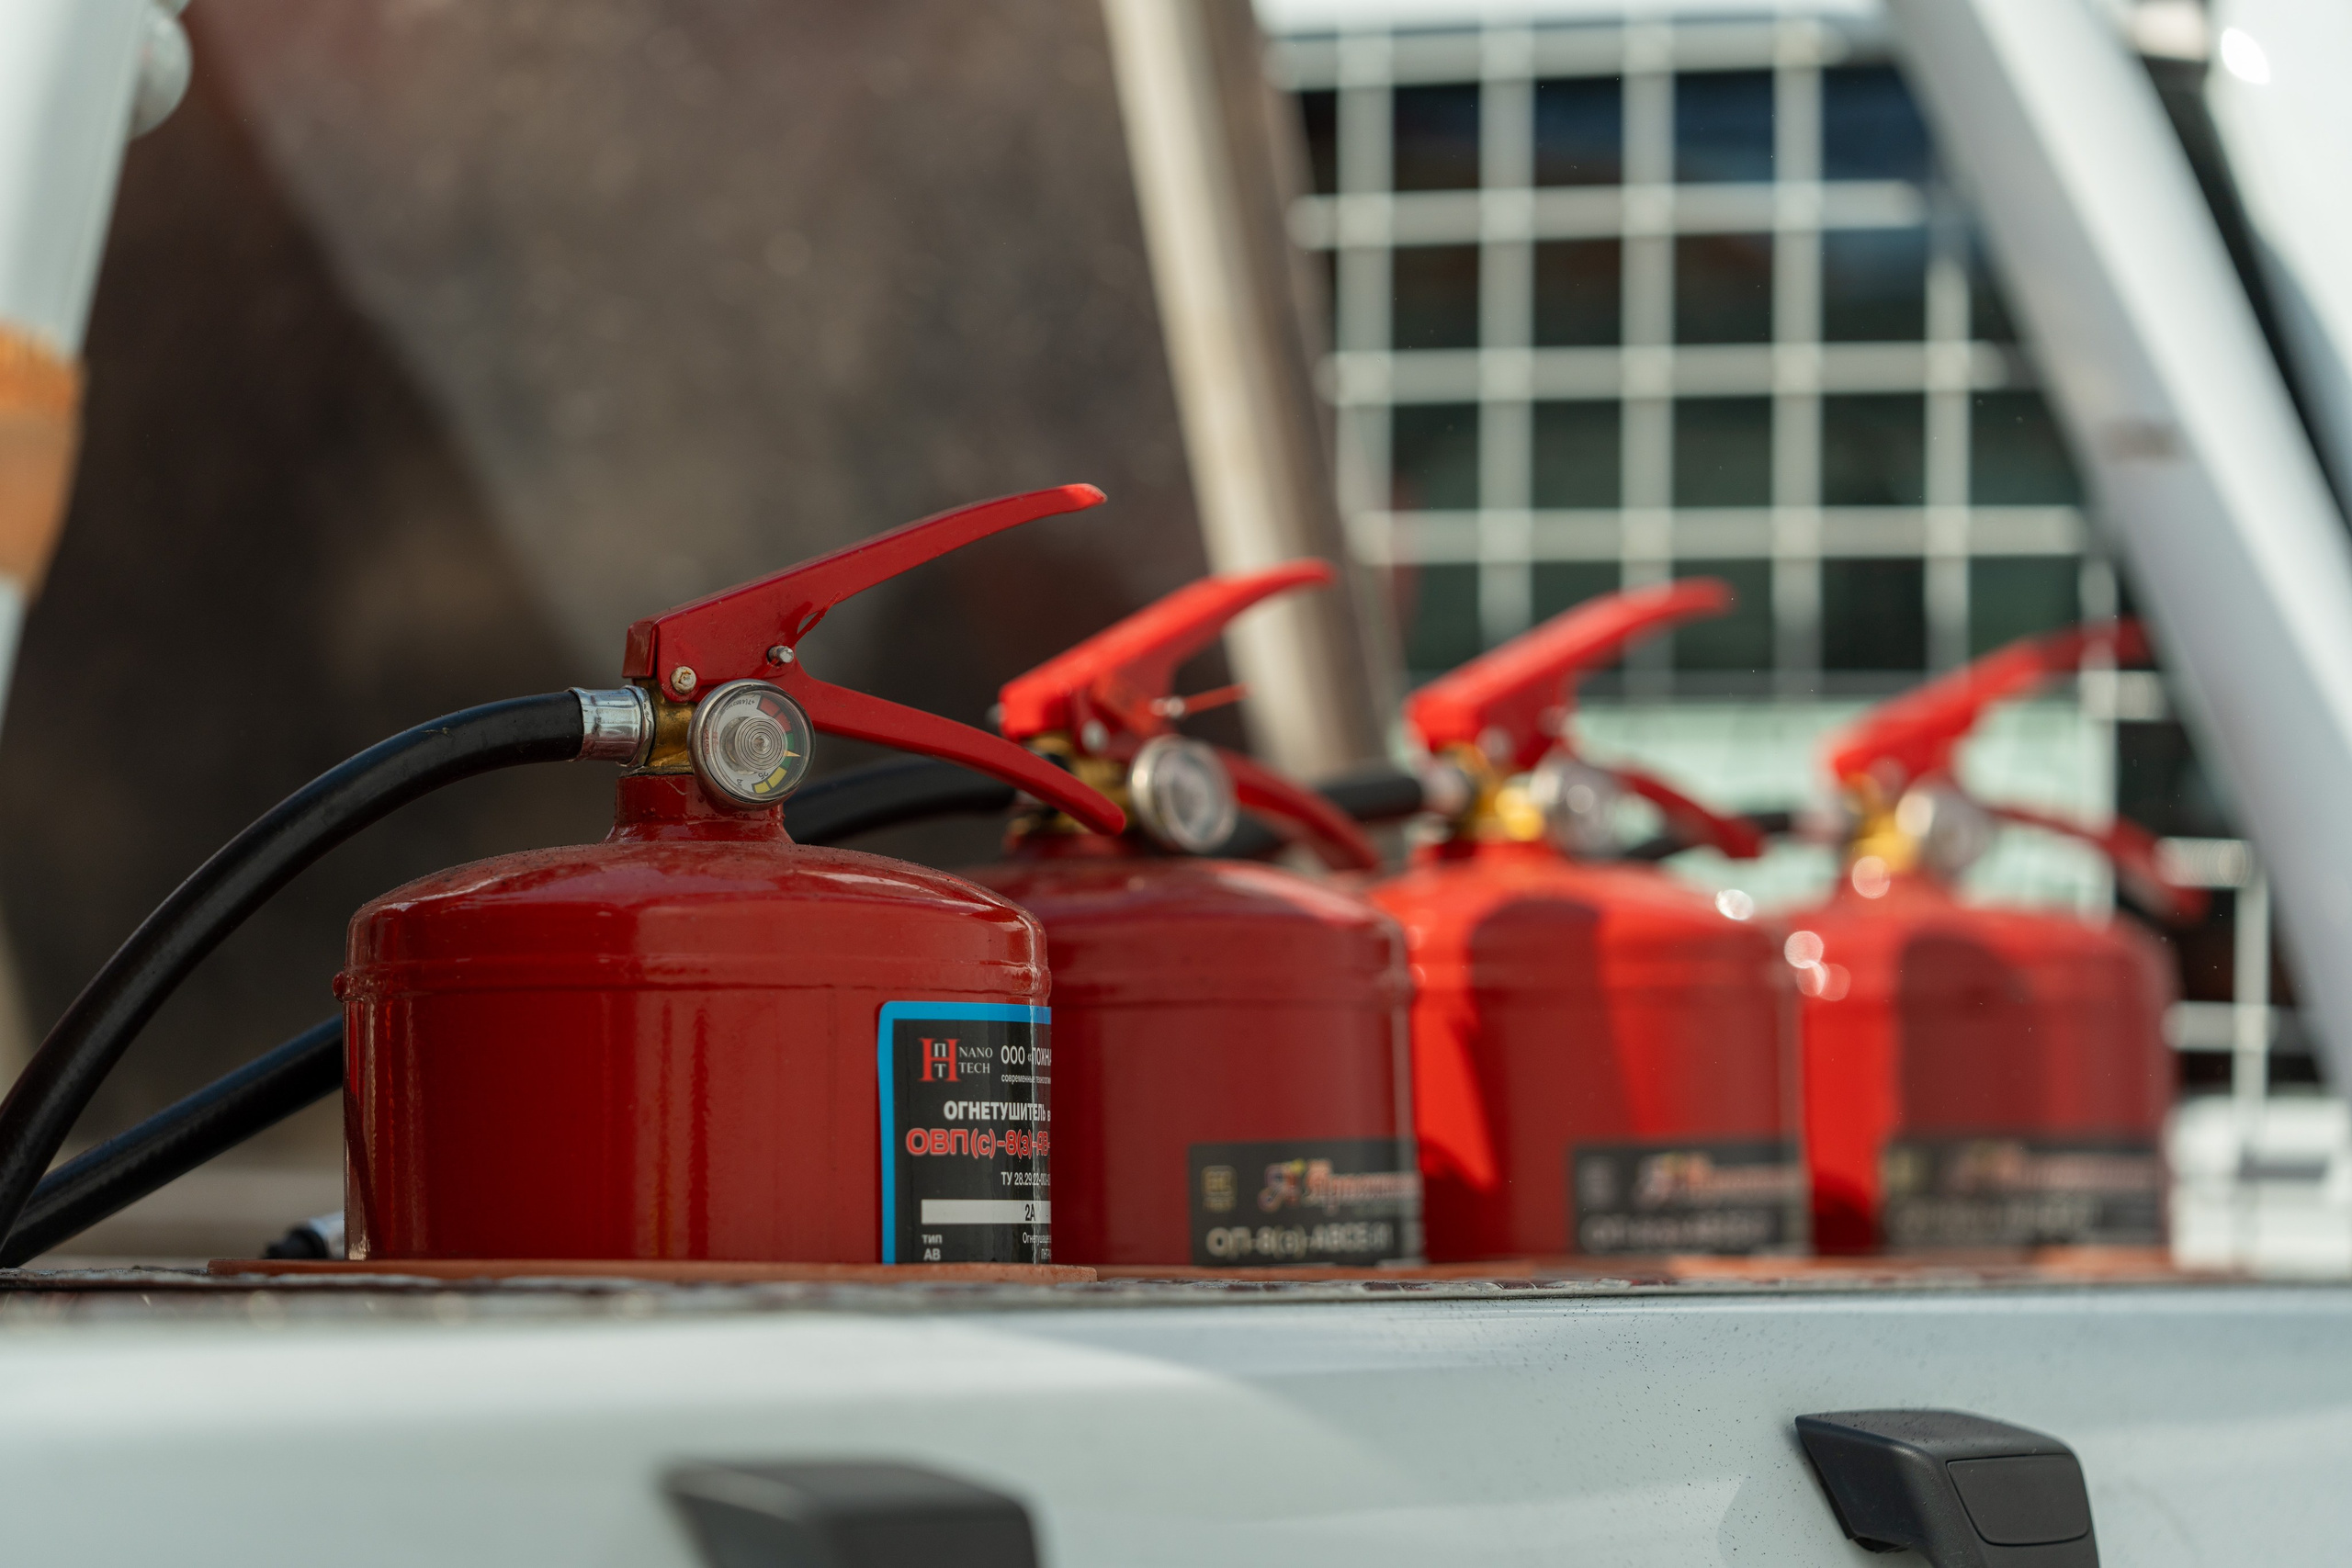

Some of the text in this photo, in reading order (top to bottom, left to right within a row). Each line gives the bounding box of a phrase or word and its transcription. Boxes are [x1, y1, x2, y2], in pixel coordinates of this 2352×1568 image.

[958, 1046, 993, 1058] NANO
[1001, 1045, 1025, 1066] ООО
[958, 1062, 990, 1074] TECH
[944, 1100, 1046, 1122] ОГНЕТУШИТЕЛЬ
[1001, 1171, 1012, 1187] ТУ
[923, 1248, 941, 1261] АВ
